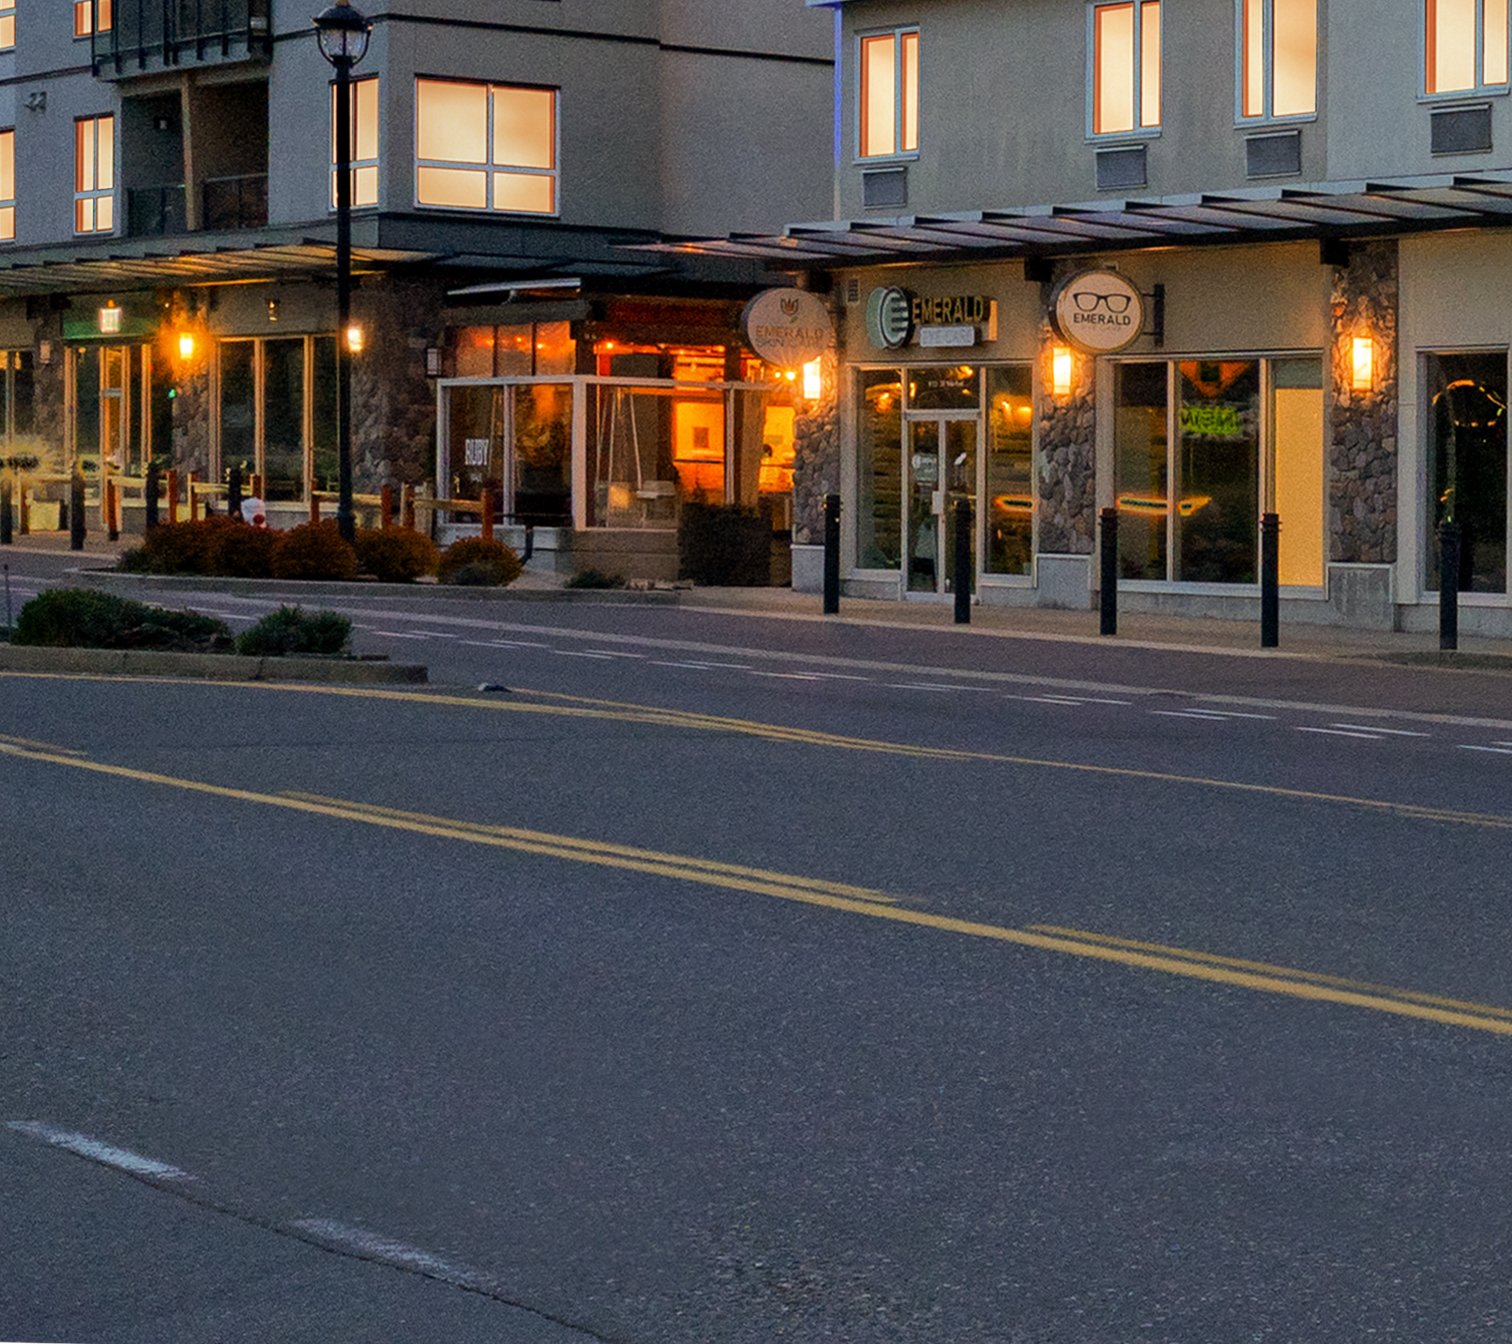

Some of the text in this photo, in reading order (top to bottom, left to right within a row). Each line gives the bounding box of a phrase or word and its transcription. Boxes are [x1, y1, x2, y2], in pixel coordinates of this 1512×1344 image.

[912, 296, 984, 325] EMERALD
[1073, 312, 1132, 326] EMERALD
[755, 324, 825, 340] EMERALD
